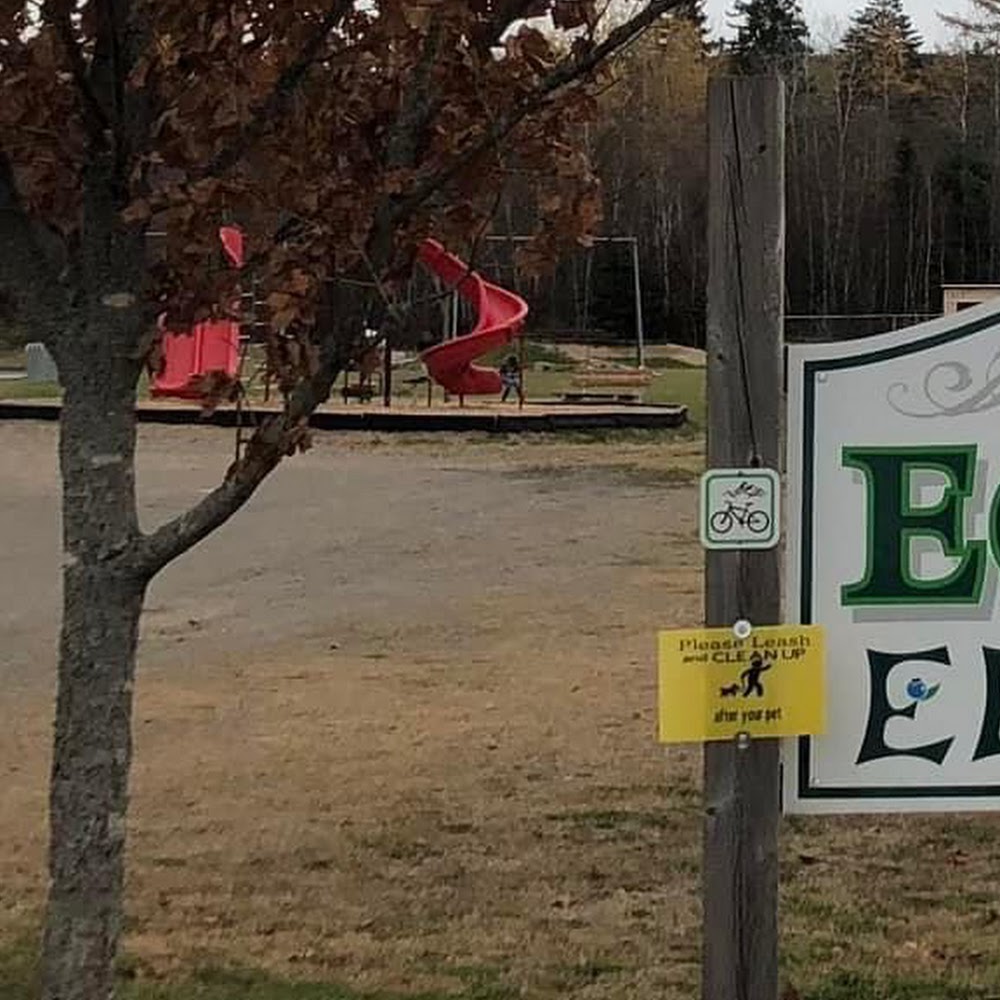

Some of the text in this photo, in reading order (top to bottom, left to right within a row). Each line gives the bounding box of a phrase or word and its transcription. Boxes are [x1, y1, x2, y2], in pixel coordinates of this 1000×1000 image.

[679, 635, 811, 651] Please Leash
[683, 648, 806, 663] and CLEAN UP
[714, 707, 783, 724] after your pet
